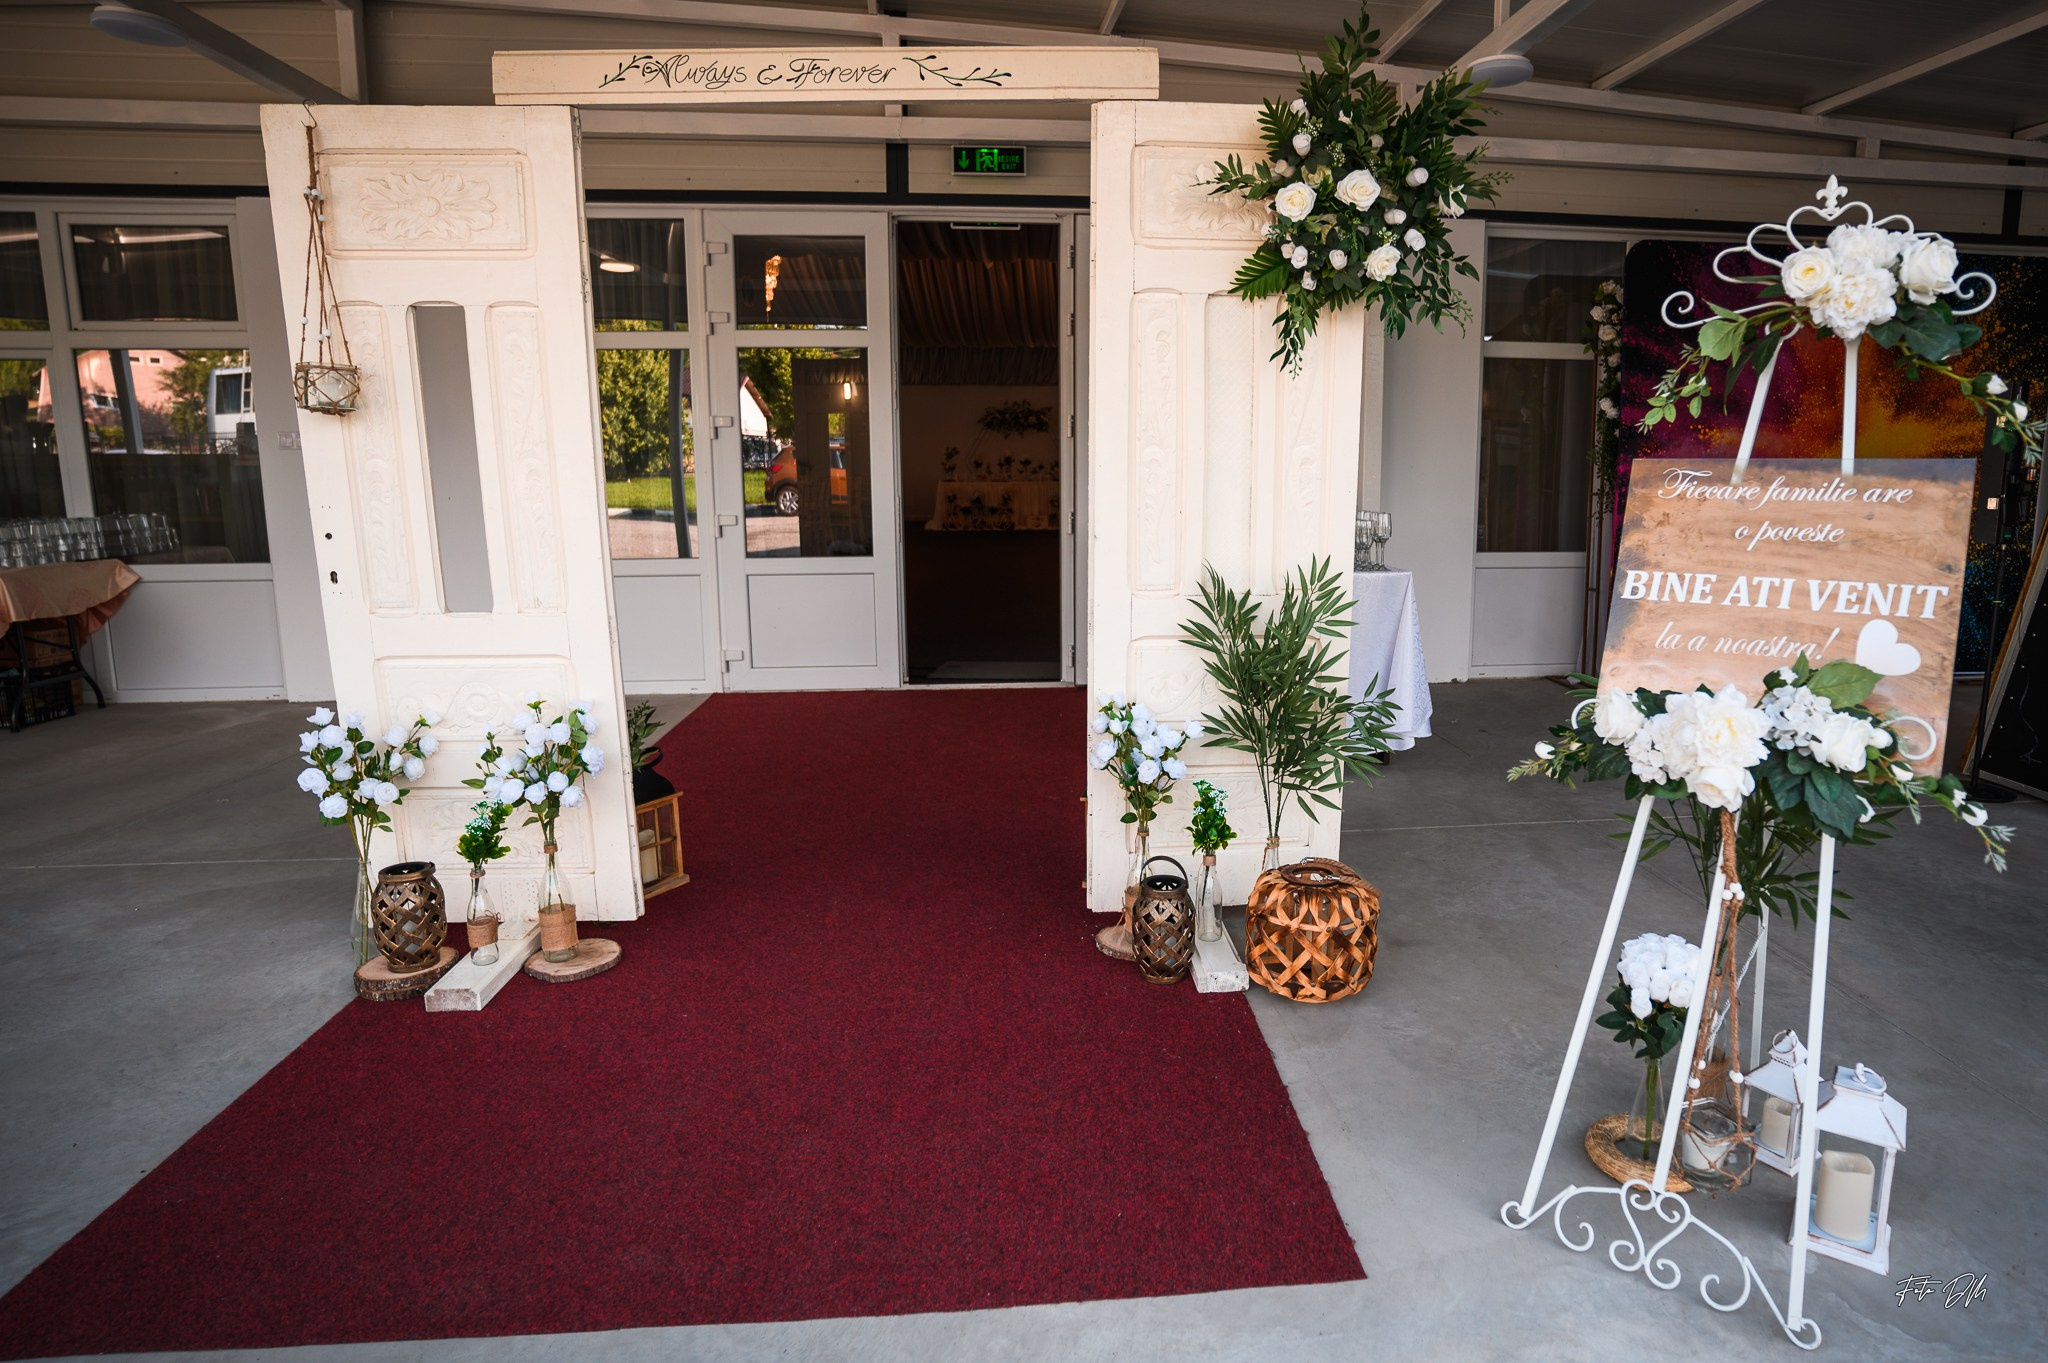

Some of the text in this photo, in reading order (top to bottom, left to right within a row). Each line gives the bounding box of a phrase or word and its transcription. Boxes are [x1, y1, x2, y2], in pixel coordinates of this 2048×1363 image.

[643, 54, 747, 89] Always
[786, 58, 896, 89] Forever
[1657, 467, 1914, 511] Fiecare familie are
[1734, 520, 1845, 551] o poveste
[1620, 570, 1949, 618] BINE ATI VENIT
[1654, 621, 1841, 660] la a noastra!
